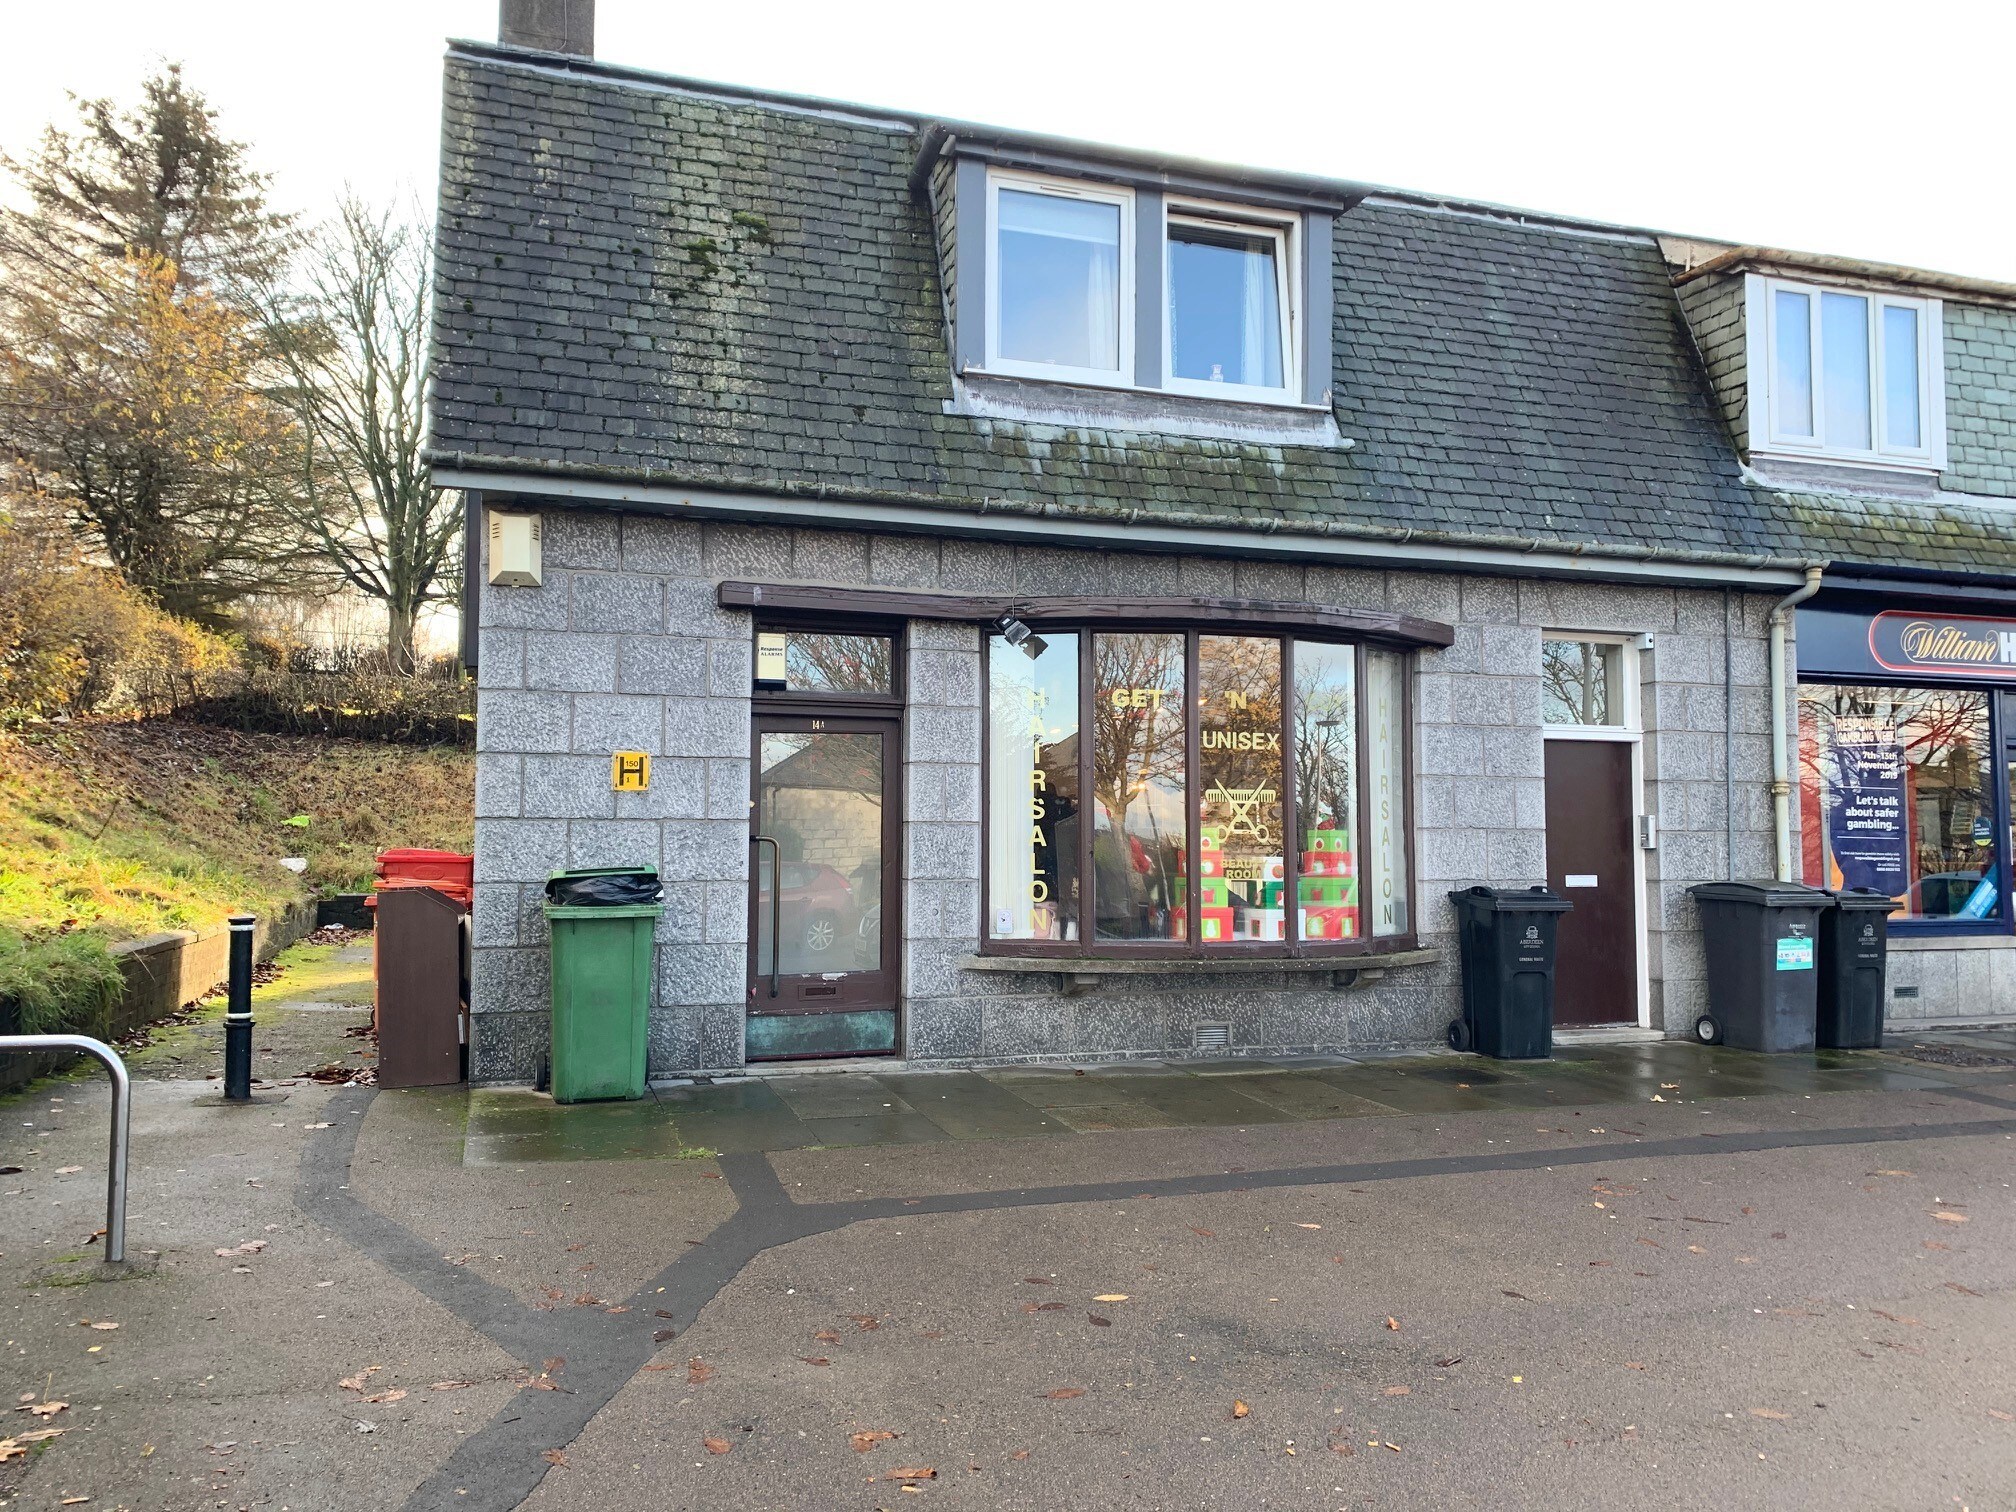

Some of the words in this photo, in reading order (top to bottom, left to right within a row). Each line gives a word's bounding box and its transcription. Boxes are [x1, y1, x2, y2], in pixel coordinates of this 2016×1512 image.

[1901, 622, 2000, 662] William
[1111, 688, 1164, 711] GET
[1836, 717, 1895, 732] RESPONSIBLE
[1202, 730, 1280, 751] UNISEX
[1838, 731, 1875, 743] GAMBLING
[625, 760, 639, 768] 150
[1858, 761, 1898, 770] November
[1880, 771, 1898, 780] 2019
[1856, 795, 1878, 806] Let's
[1879, 796, 1899, 806] talk
[1845, 806, 1874, 817] about
[1874, 808, 1899, 818] safer
[1846, 819, 1900, 831] gambling...
[1226, 869, 1261, 879] ROOM
